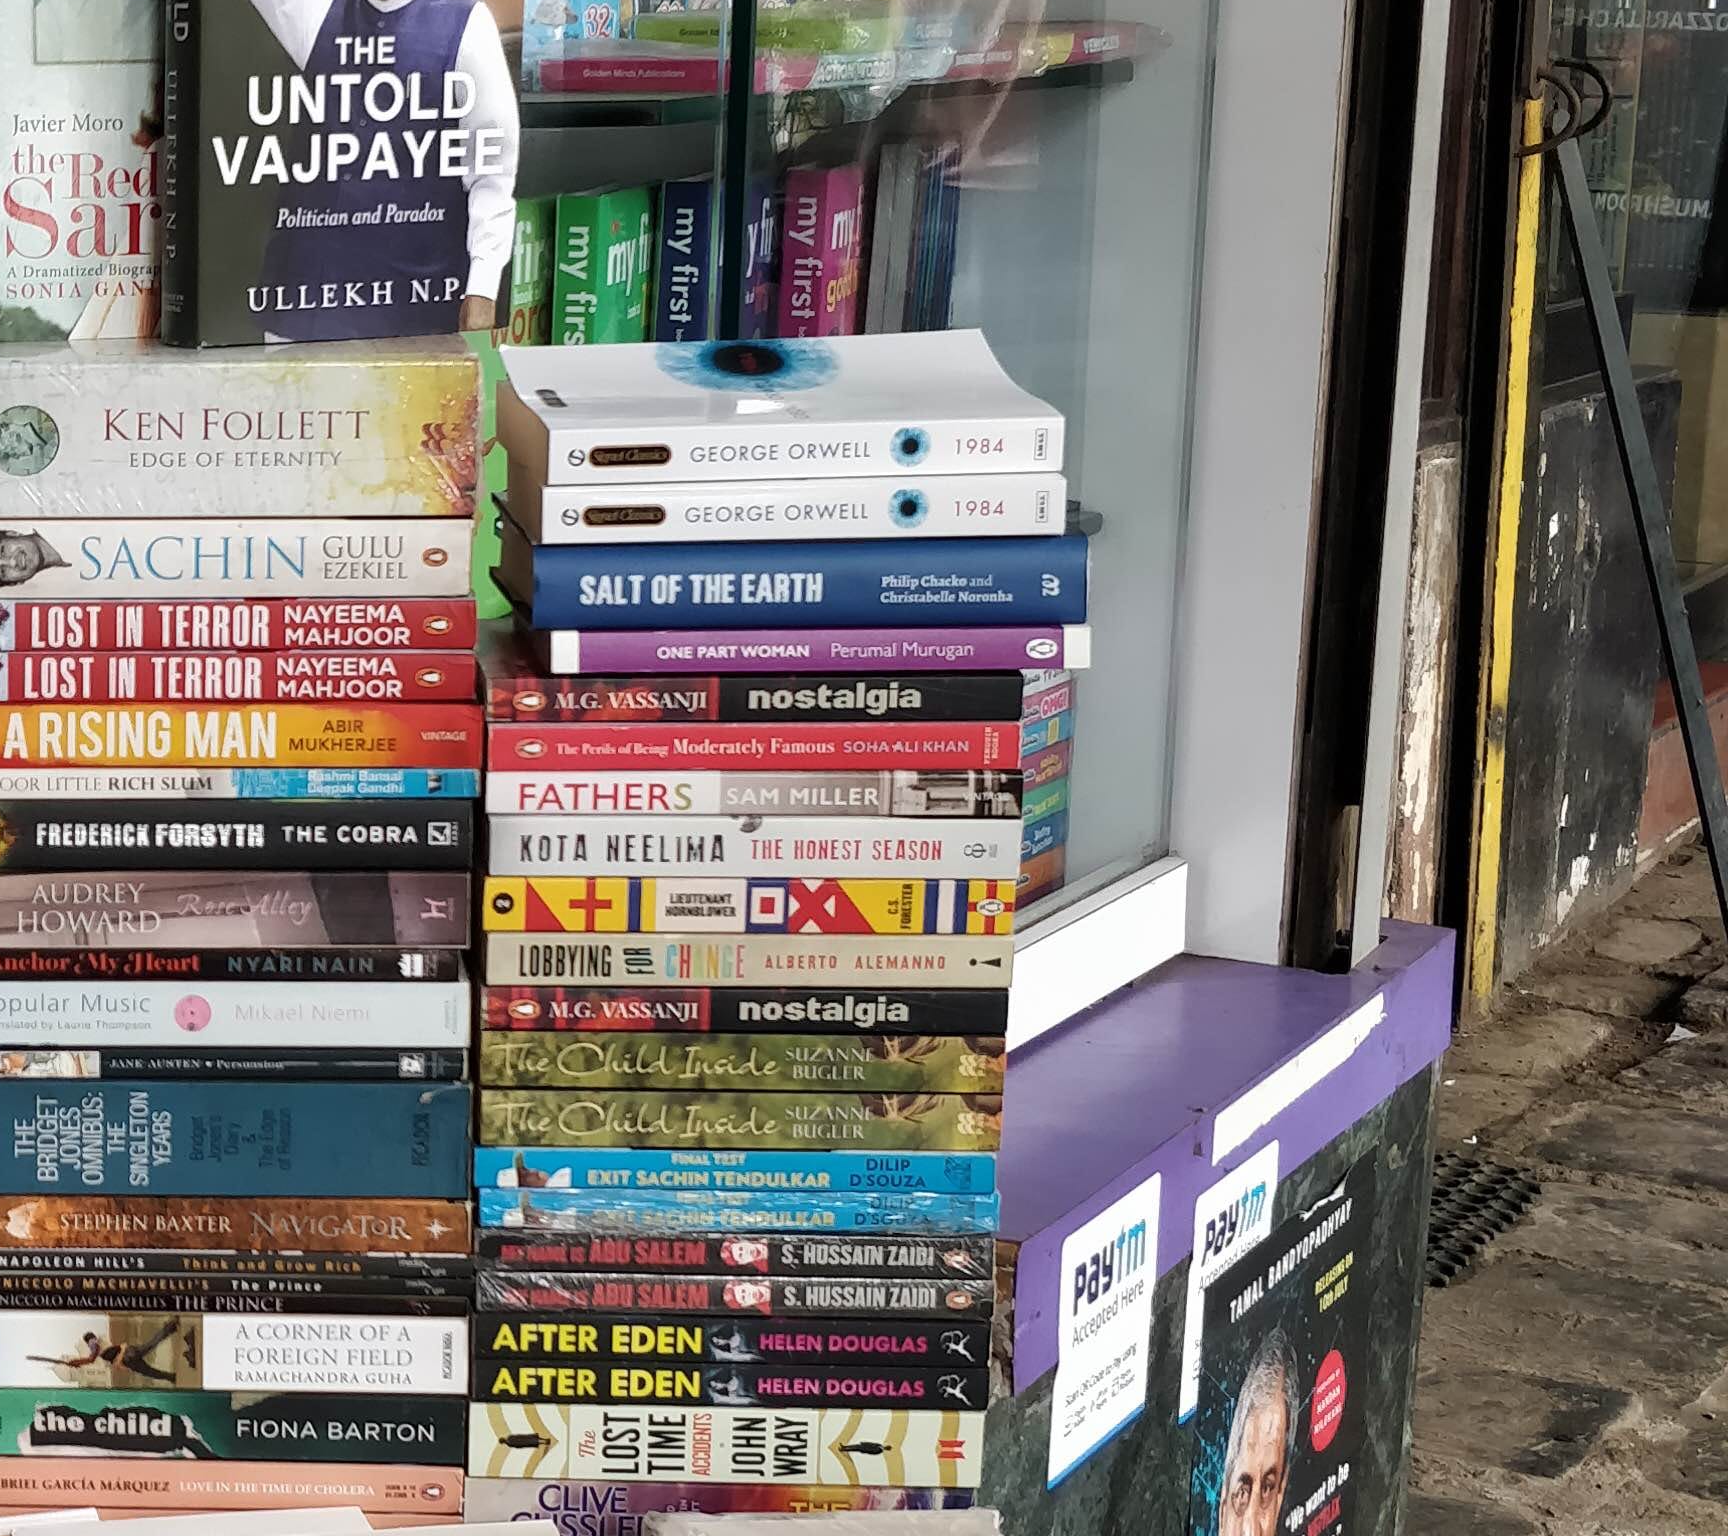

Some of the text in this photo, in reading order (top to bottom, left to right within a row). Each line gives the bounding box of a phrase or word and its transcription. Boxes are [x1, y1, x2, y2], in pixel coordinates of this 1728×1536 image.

[335, 36, 395, 65] THE
[247, 69, 477, 126] UNTOLD
[12, 112, 123, 135] Javier Moro
[212, 128, 505, 185] VAJPAYEE
[275, 203, 445, 228] Politician and Paradox
[247, 274, 466, 312] ULLEKH N.P.
[690, 444, 779, 463] GEORGE
[788, 442, 871, 460] ORWELL
[954, 437, 1005, 456] 1984
[79, 535, 307, 581] SACHIN
[580, 573, 823, 604] SALT OF THE EARTH
[31, 605, 270, 648] LOST IN TERROR
[656, 644, 810, 660] ONE PART WOMAN
[748, 682, 922, 715] nostalgia
[1071, 1277, 1147, 1349] Accepted Here
[492, 1322, 703, 1354] AFTER EDEN
[236, 1419, 436, 1443] FIONA BARTON
